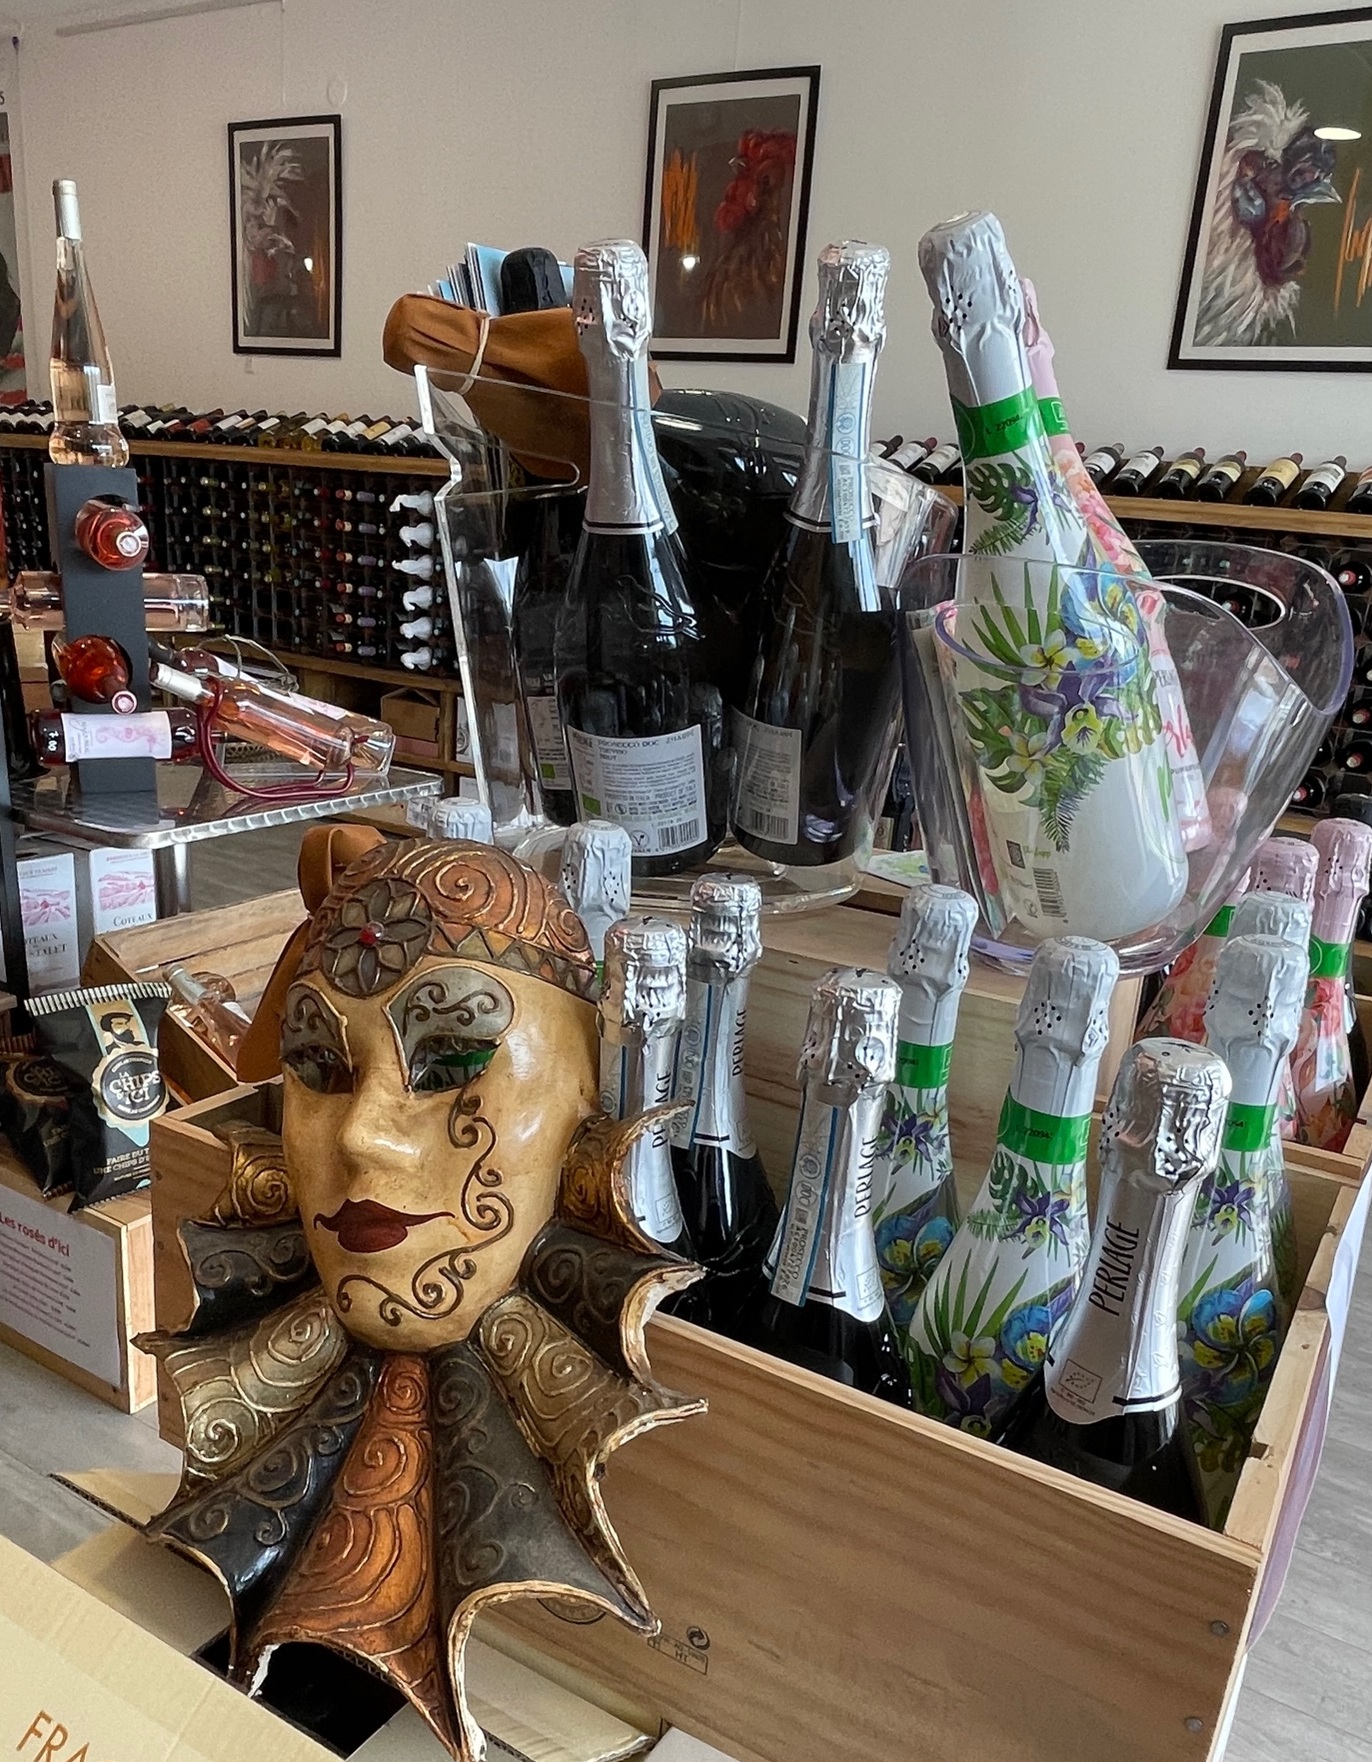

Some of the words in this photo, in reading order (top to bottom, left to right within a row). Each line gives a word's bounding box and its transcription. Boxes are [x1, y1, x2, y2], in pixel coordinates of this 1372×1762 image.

[109, 1070, 161, 1094] CHIPS
[651, 1073, 671, 1148] PEAGE
[1088, 1216, 1140, 1316] PERLAGE
